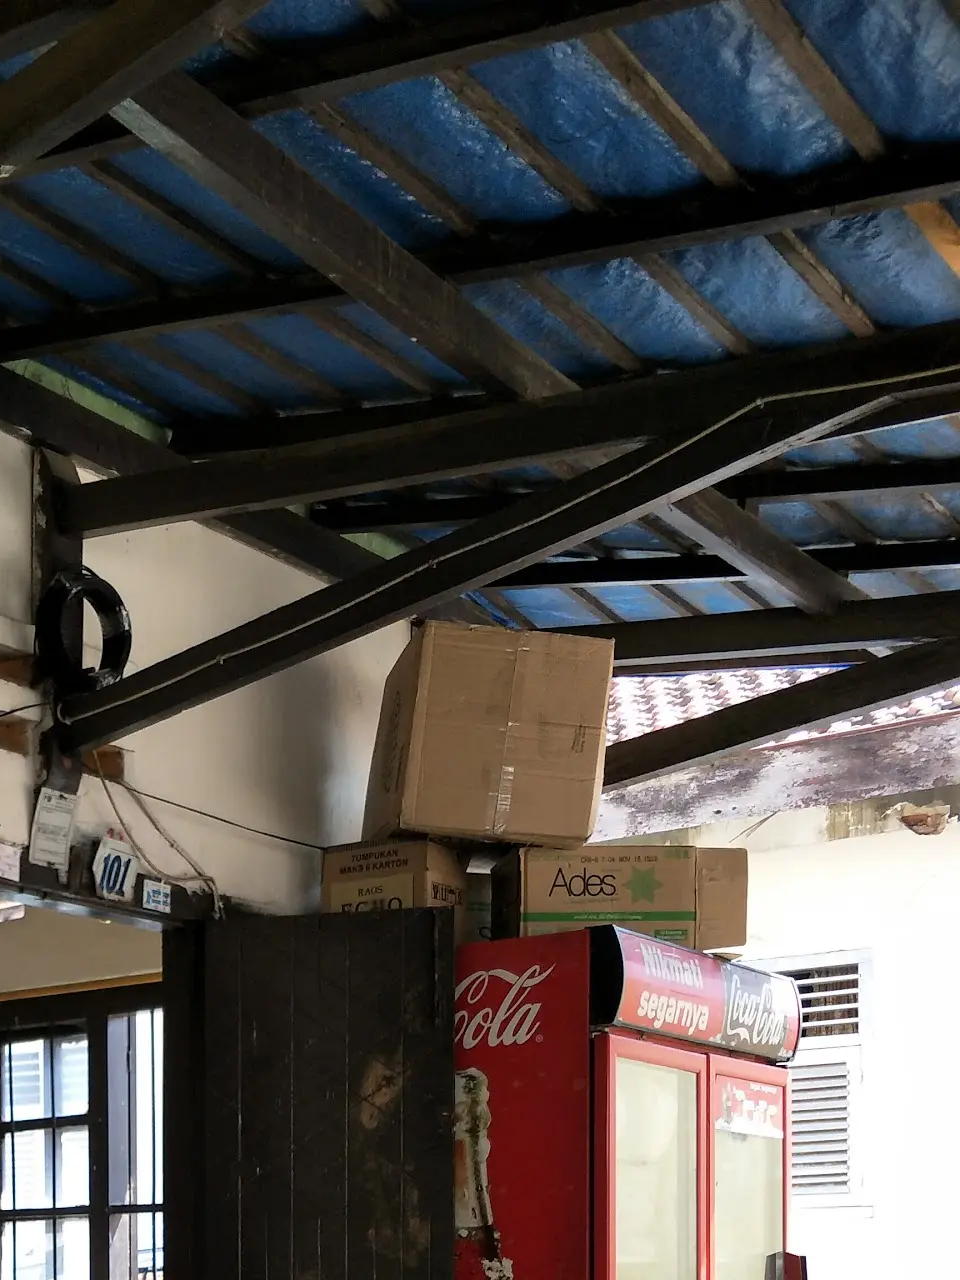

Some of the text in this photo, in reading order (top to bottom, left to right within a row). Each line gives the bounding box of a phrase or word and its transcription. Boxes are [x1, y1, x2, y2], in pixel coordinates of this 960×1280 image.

[100, 852, 132, 897] 101
[350, 849, 400, 863] TUMPUKAN
[373, 858, 409, 872] KARTON
[549, 866, 617, 897] Ades
[640, 941, 704, 990] Nikmati
[637, 990, 710, 1036] segarnya
